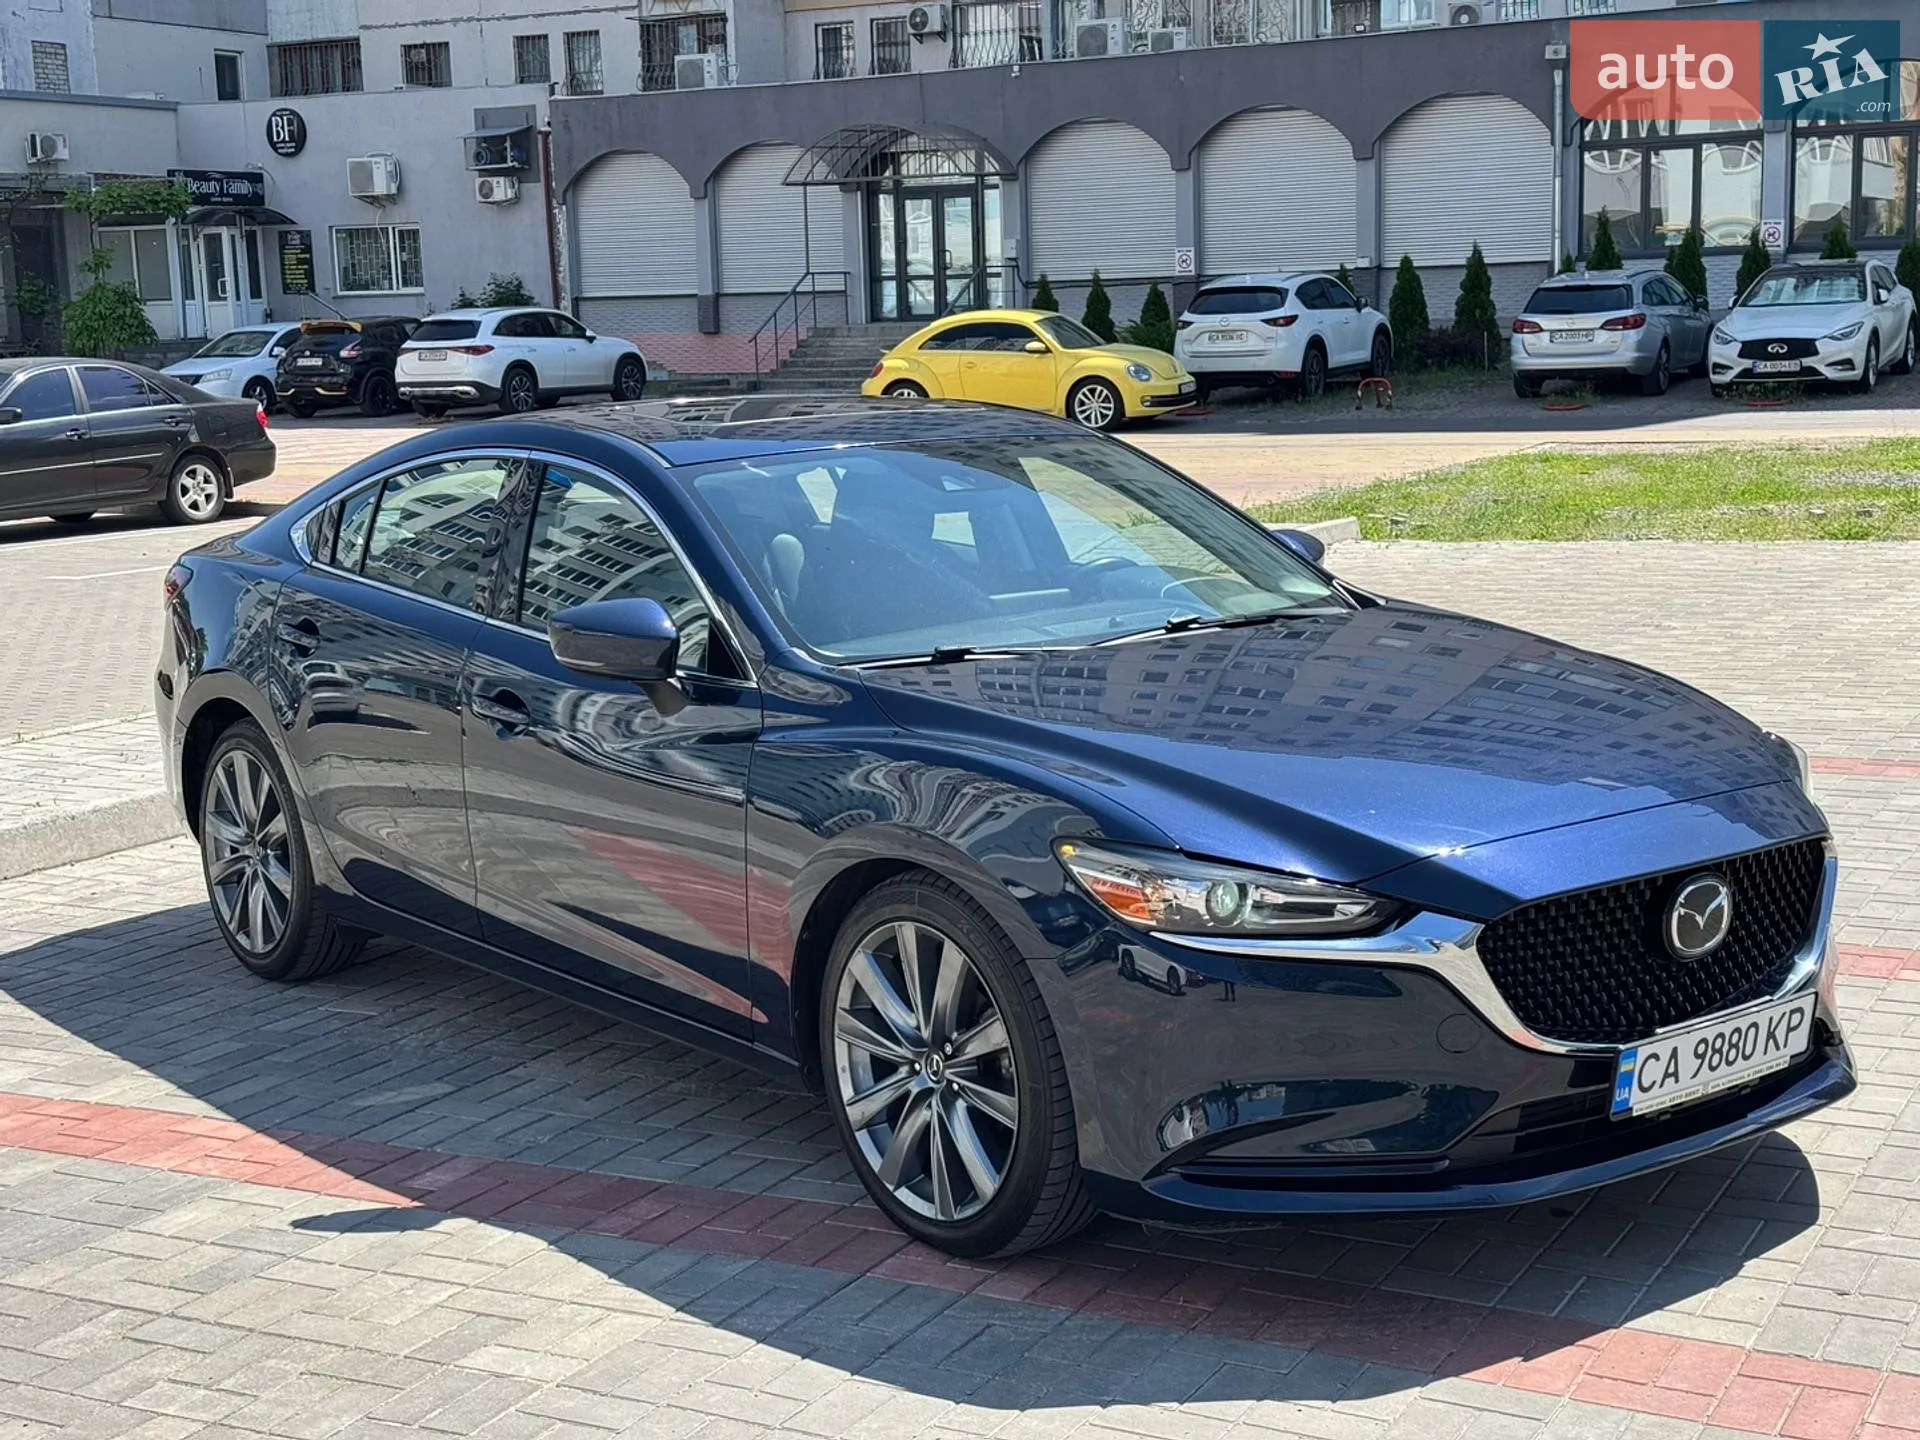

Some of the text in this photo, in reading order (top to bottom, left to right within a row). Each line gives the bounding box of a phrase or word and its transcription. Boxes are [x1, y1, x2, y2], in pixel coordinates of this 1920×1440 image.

[271, 115, 294, 141] BF
[187, 178, 253, 198] Beauty Family
[1637, 1046, 1680, 1093] CA
[1690, 1021, 1760, 1080] 9880
[1763, 1006, 1805, 1056] KP
[1616, 1087, 1630, 1101] UA
